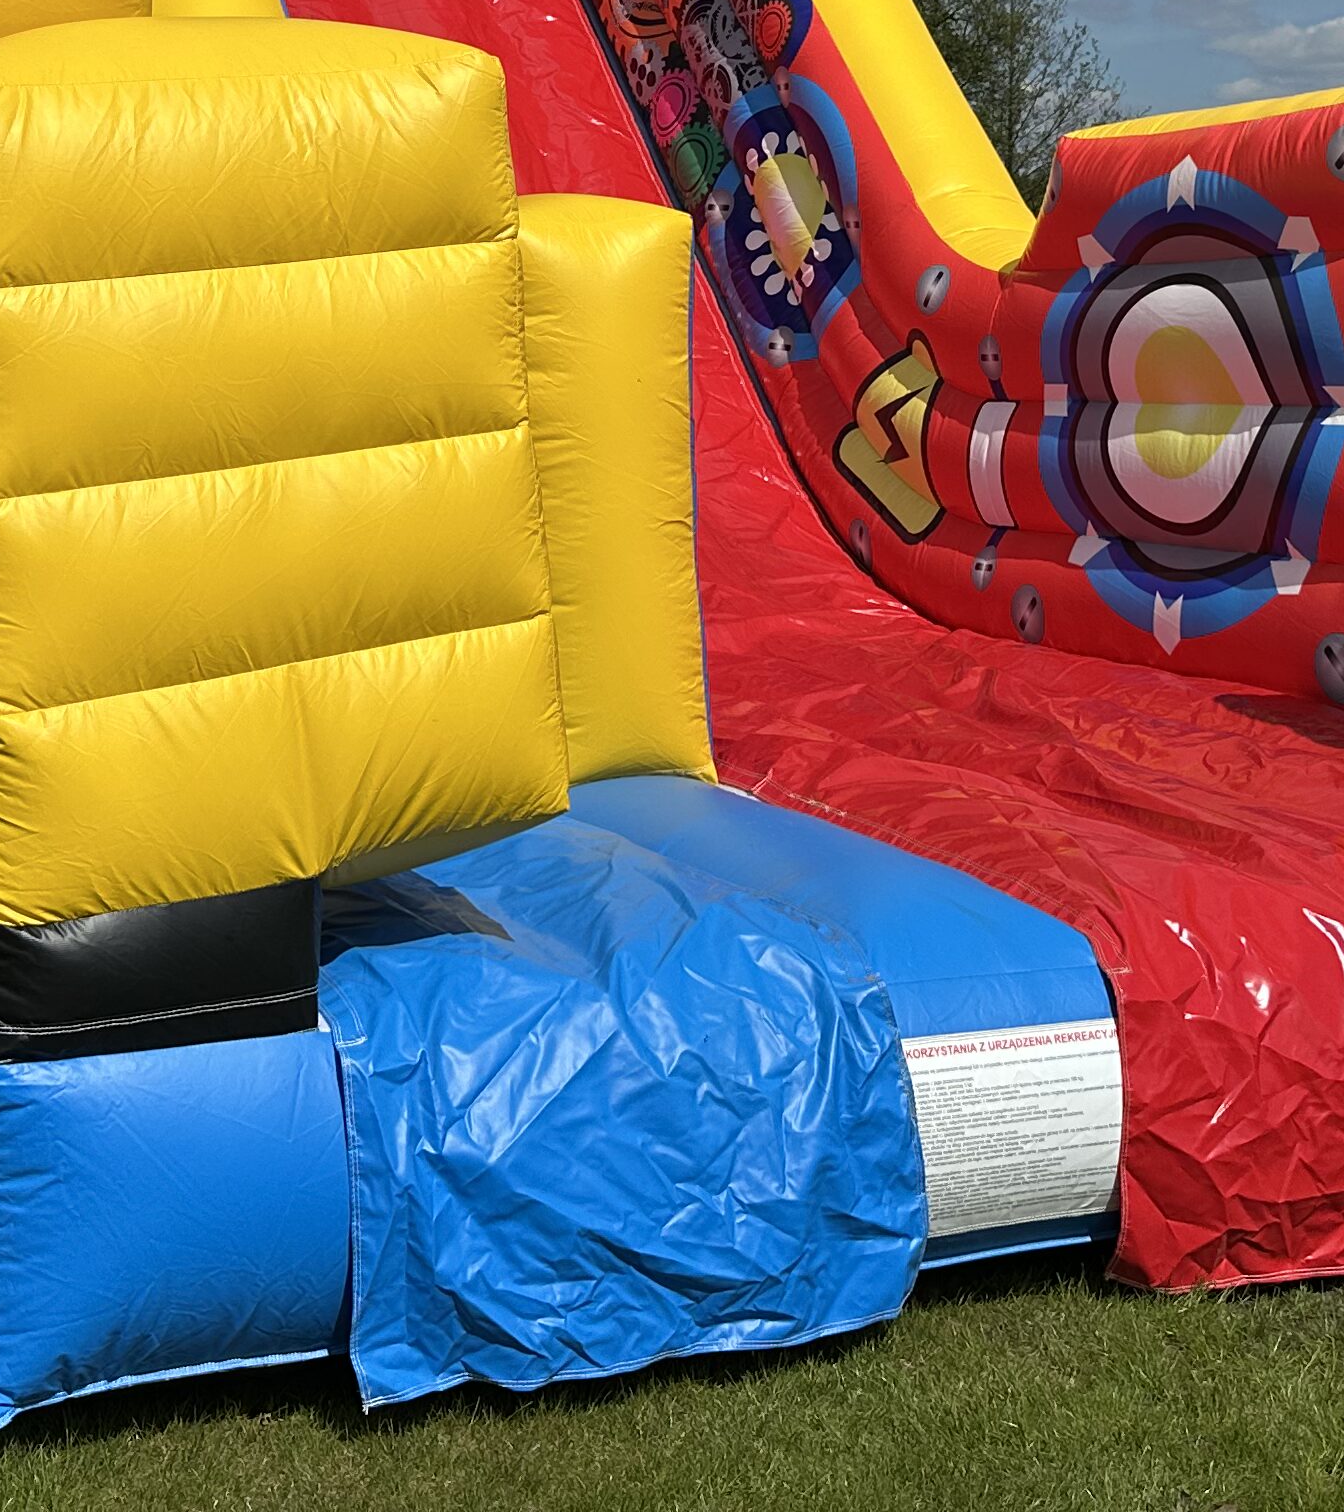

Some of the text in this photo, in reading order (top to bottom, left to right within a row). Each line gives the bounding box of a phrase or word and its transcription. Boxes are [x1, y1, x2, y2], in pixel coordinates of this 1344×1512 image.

[906, 1043, 977, 1059] KORZYSTANIA
[979, 1042, 986, 1052] Z
[988, 1035, 1052, 1051] URZĄDZENIA
